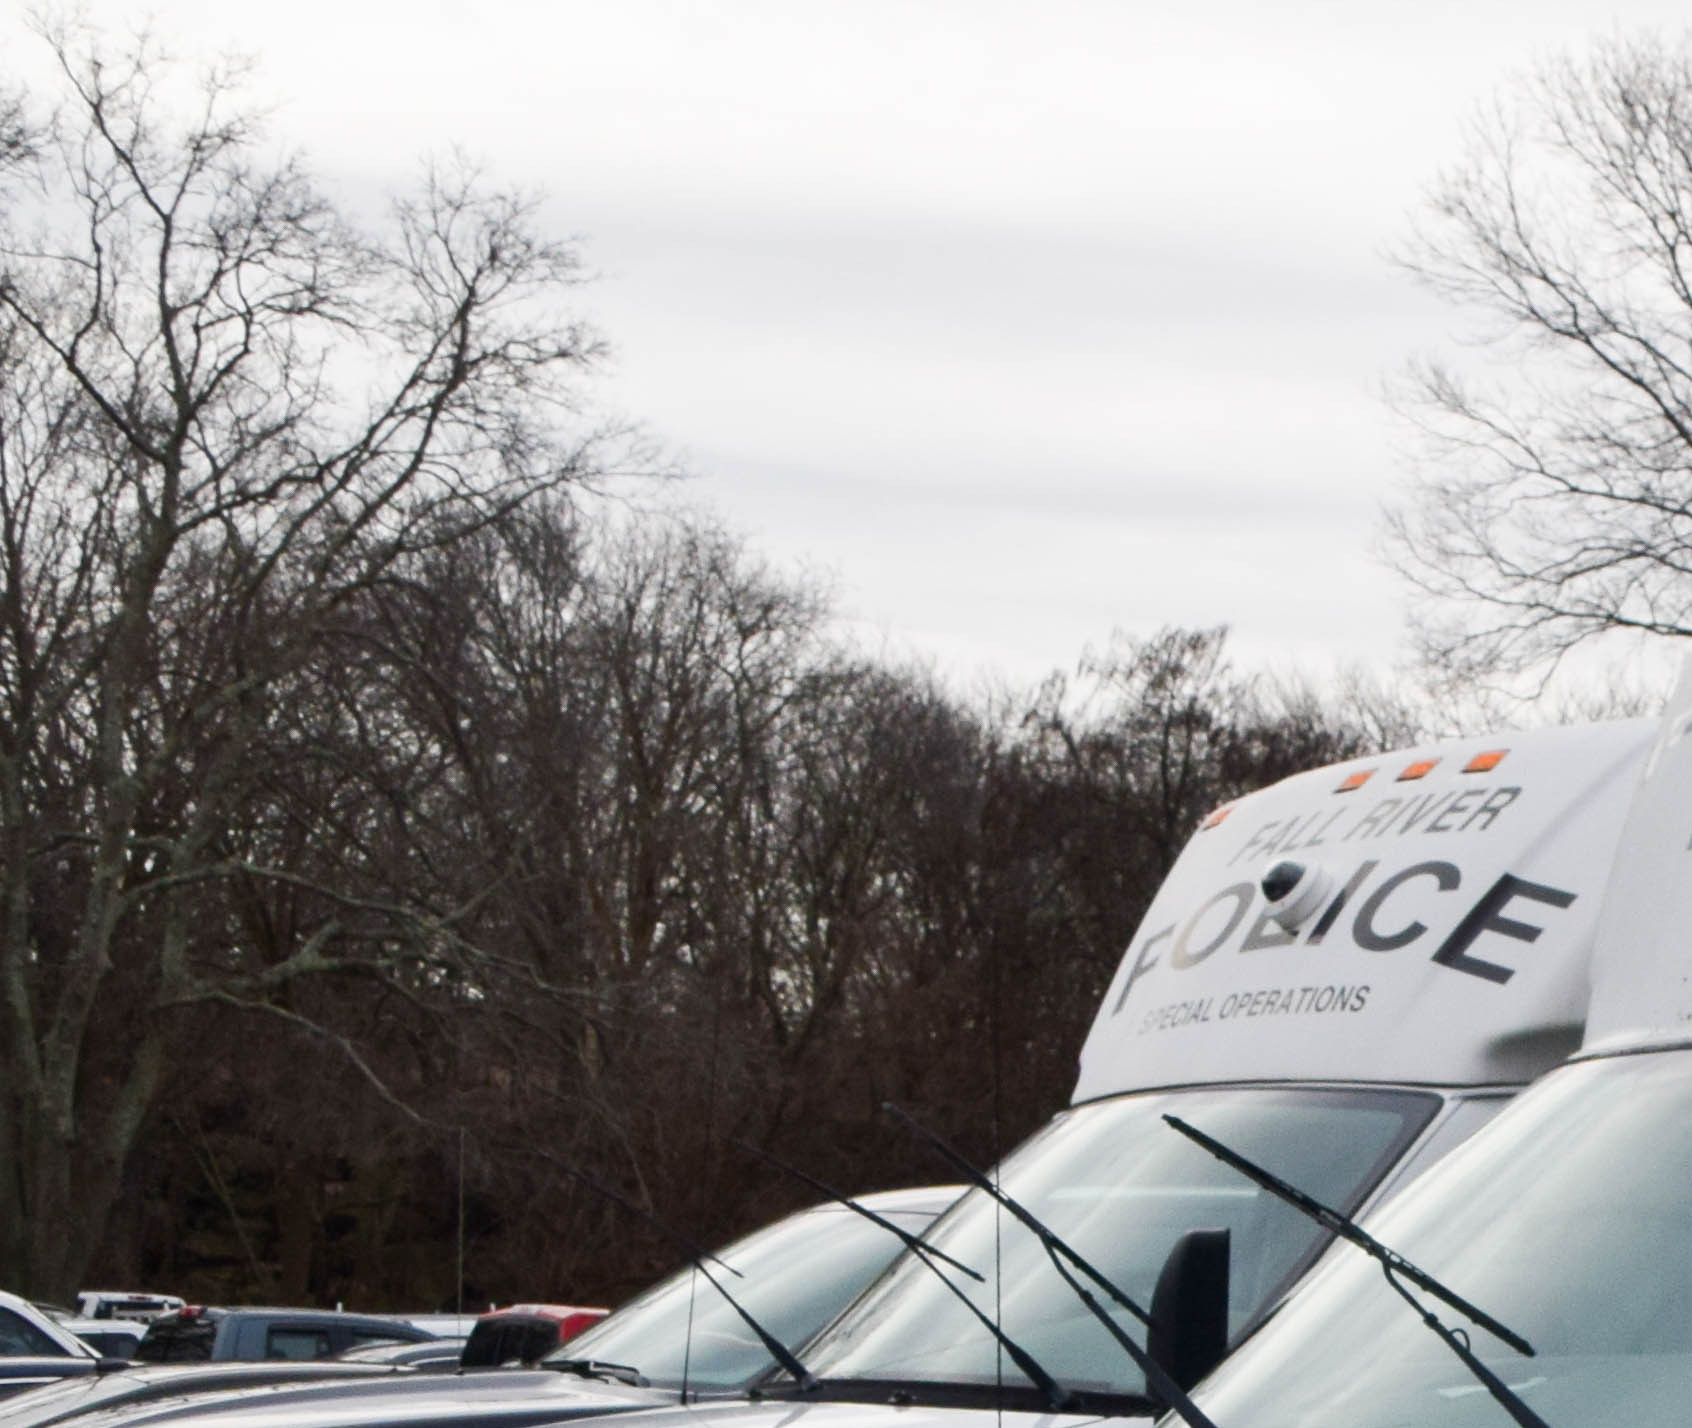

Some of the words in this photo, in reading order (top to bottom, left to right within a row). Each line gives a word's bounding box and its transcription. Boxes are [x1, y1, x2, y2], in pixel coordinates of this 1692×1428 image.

[1226, 805, 1346, 868] FALL
[1345, 786, 1523, 842] RIVER
[1138, 997, 1214, 1036] SPECIAL
[1218, 985, 1371, 1019] OPERATIONS
